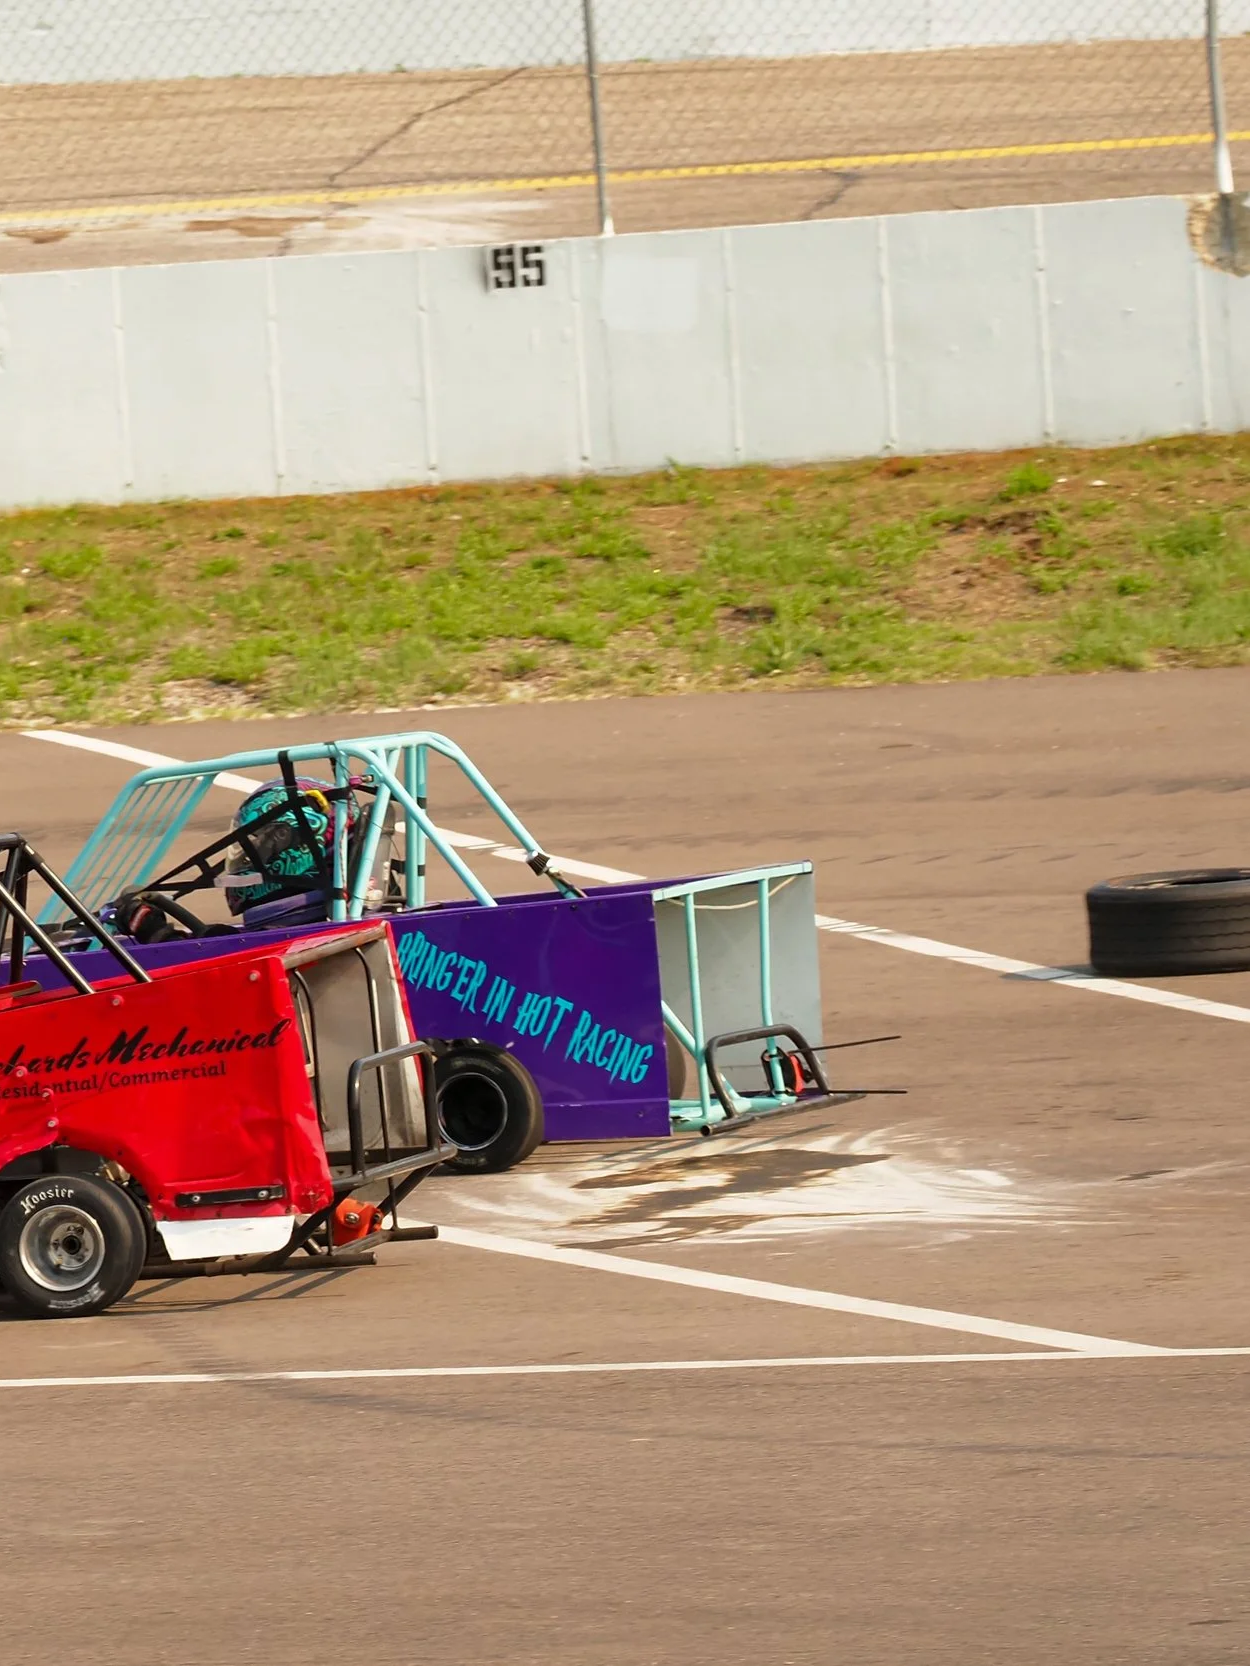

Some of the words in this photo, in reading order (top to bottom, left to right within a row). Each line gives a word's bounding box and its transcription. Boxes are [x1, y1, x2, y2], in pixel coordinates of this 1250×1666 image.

[492, 245, 545, 289] 55
[94, 1018, 292, 1066] Mechanical
[481, 975, 517, 1027] IN
[512, 992, 574, 1054] HOT
[564, 1010, 655, 1085] RACING
[20, 1184, 76, 1216] Hoosier
